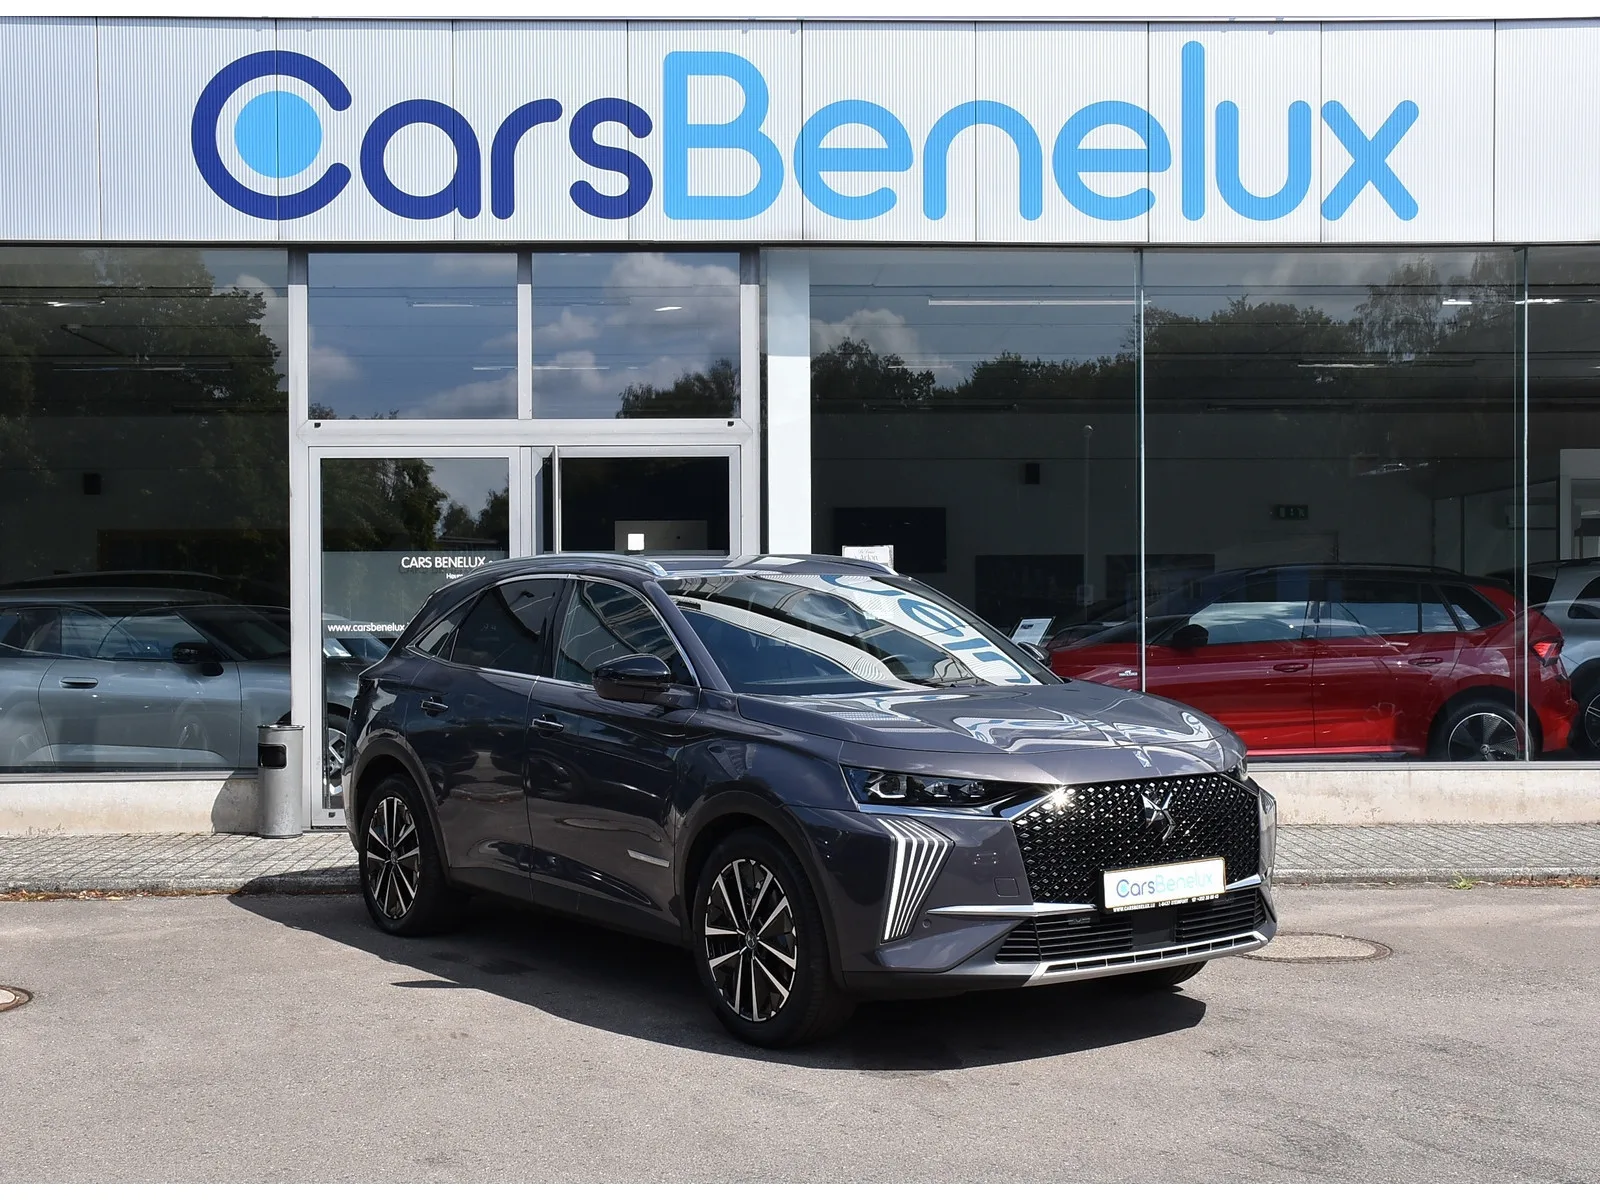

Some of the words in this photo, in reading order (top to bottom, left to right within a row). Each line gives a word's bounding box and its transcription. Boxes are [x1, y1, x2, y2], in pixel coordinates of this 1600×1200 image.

[191, 41, 1419, 221] CarsBenelux
[401, 556, 432, 569] CARS
[434, 556, 486, 568] BENELUX
[327, 622, 410, 632] www.carsbenelux
[1116, 869, 1213, 898] CarsBenelux
